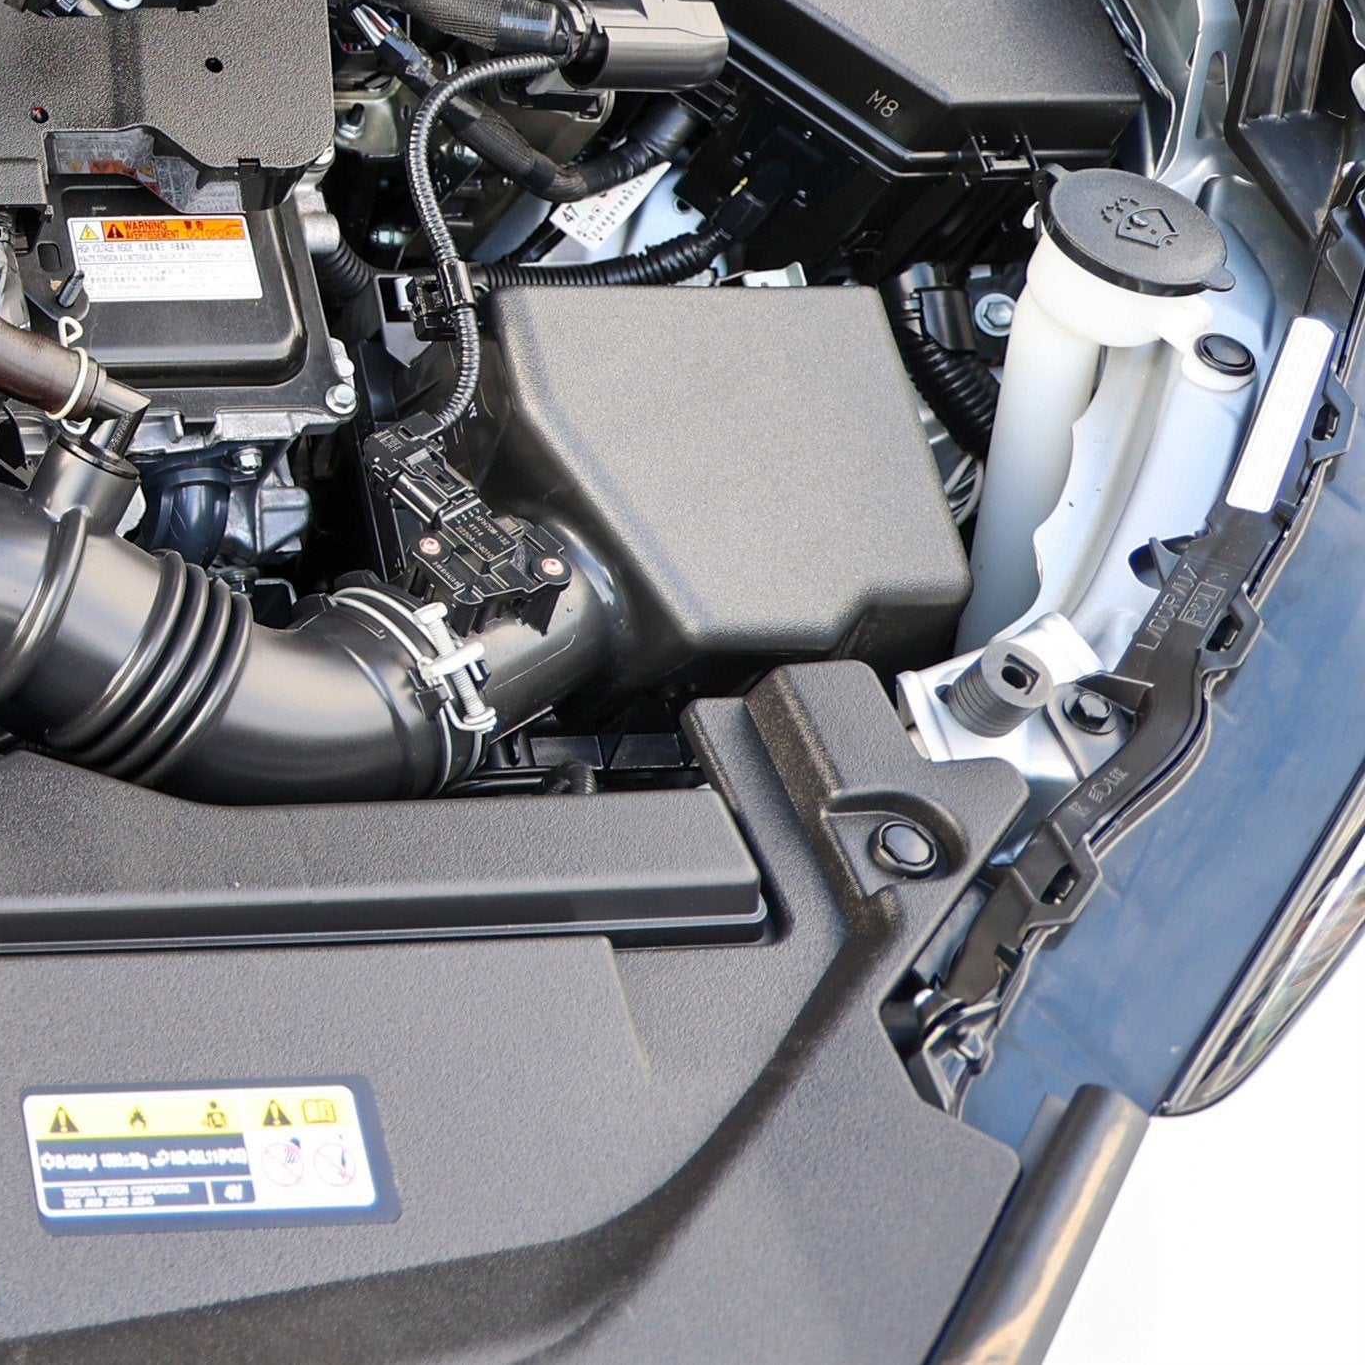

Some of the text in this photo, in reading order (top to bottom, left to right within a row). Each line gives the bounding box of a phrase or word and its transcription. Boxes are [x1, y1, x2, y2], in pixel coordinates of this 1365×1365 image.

[866, 89, 899, 117] M8
[562, 204, 579, 223] 47
[123, 220, 168, 231] WARNING
[126, 229, 179, 240] AVERTISSEMENT
[97, 1185, 129, 1197] MOTOR
